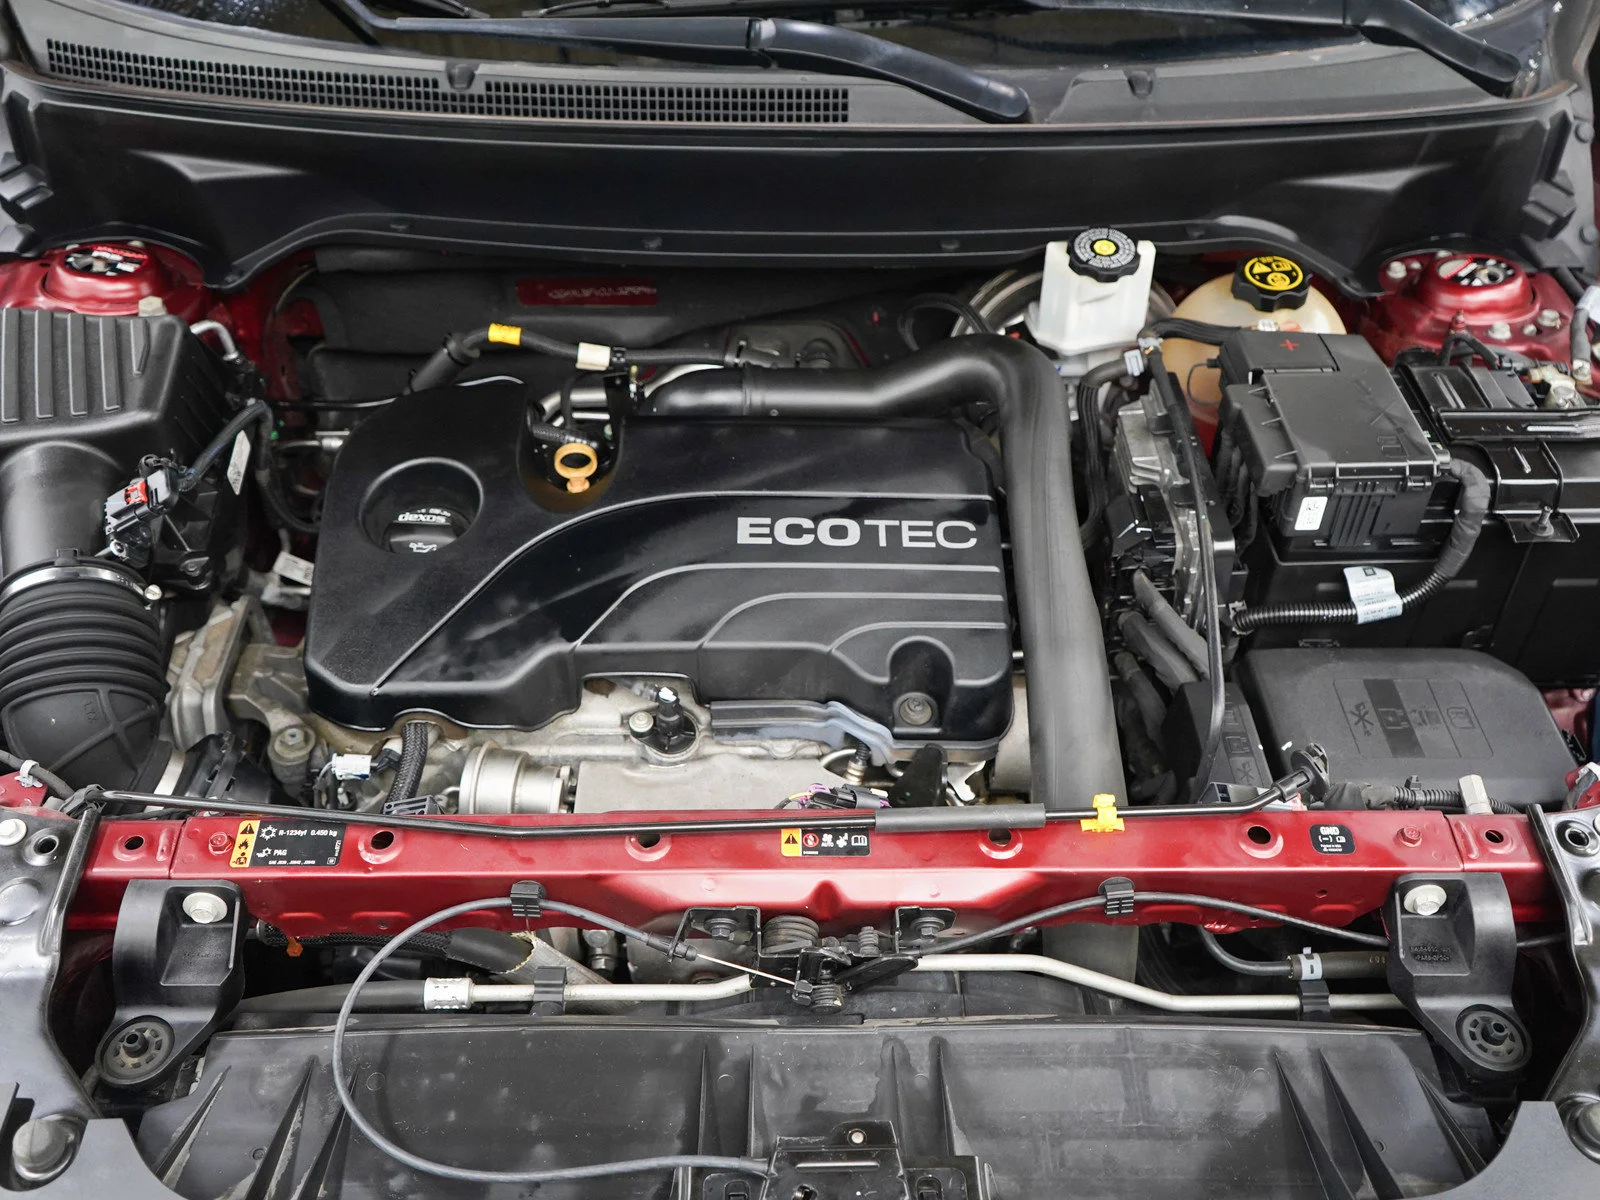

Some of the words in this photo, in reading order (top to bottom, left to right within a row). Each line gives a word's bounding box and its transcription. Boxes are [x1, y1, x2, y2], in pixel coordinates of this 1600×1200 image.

[397, 512, 446, 523] dexos
[737, 517, 978, 549] ECOTEC
[278, 829, 308, 838] R-1234yf
[329, 829, 338, 838] kg
[1319, 826, 1340, 835] GND
[273, 849, 288, 857] PAG
